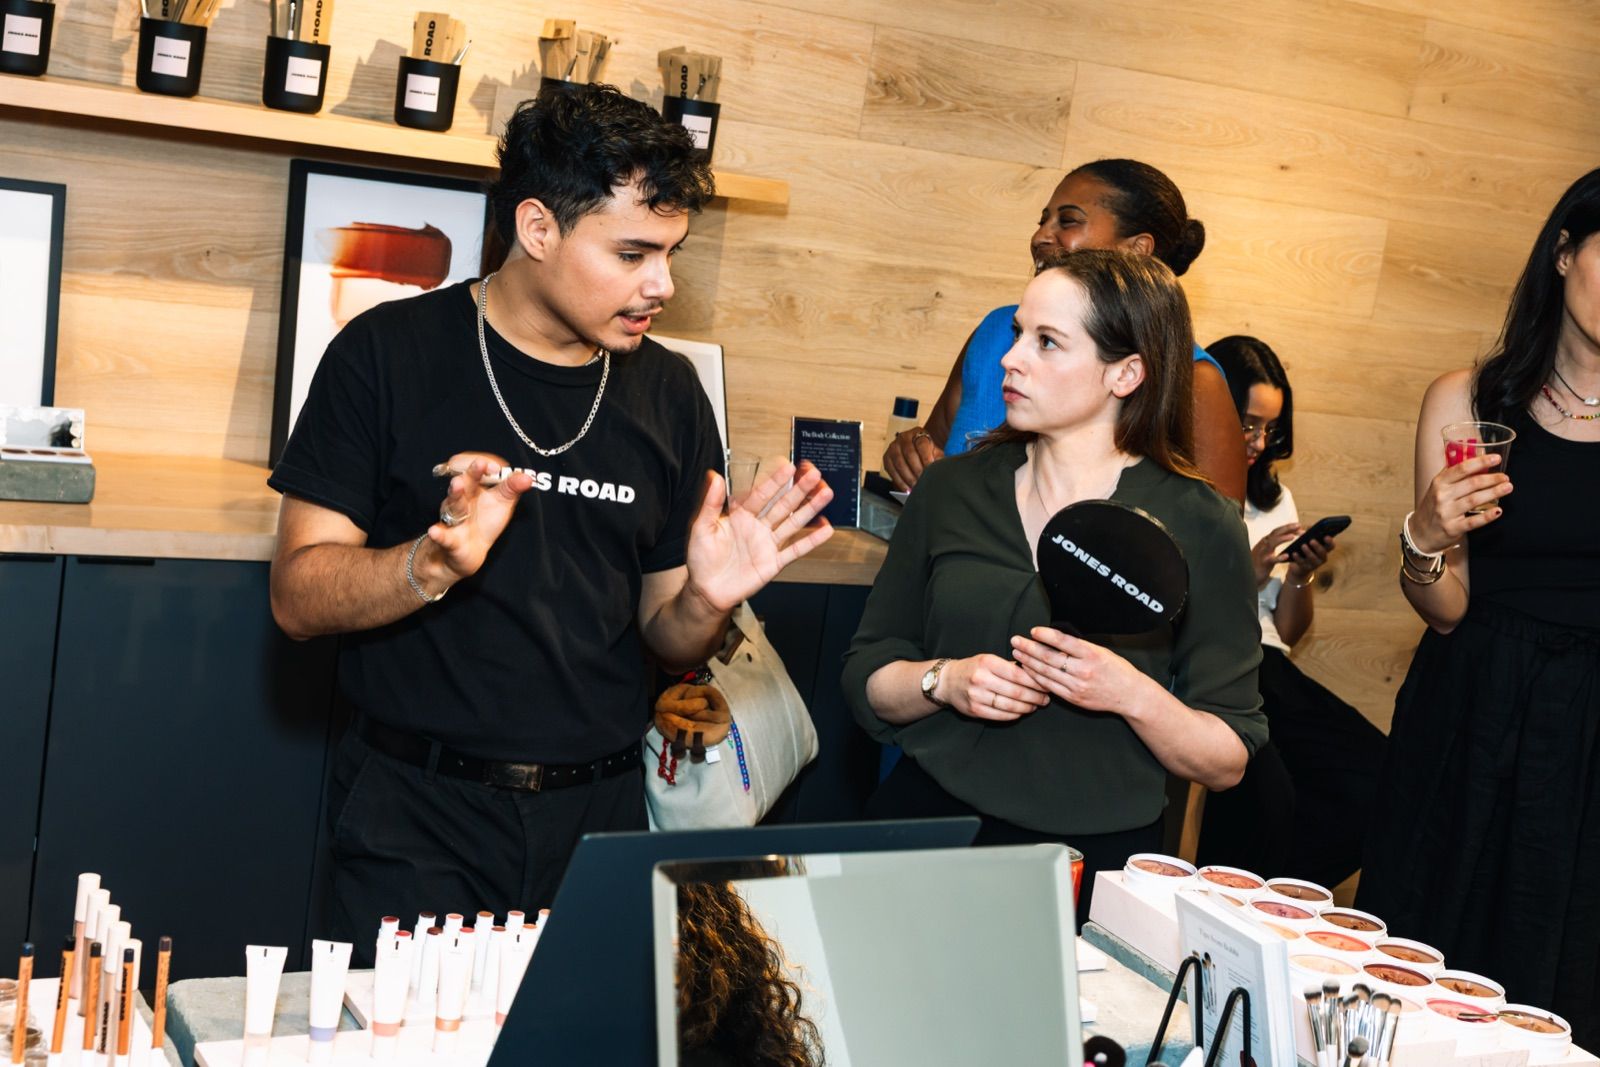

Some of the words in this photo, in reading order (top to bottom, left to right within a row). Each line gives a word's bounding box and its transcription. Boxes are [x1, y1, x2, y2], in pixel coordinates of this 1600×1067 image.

[313, 0, 323, 37] ROAD
[424, 20, 436, 56] ROAD
[680, 65, 688, 98] ROAD
[801, 430, 811, 438] The
[500, 466, 553, 491] NES
[557, 475, 635, 504] ROAD
[1051, 533, 1111, 577] JONES
[1110, 573, 1164, 613] ROAD
